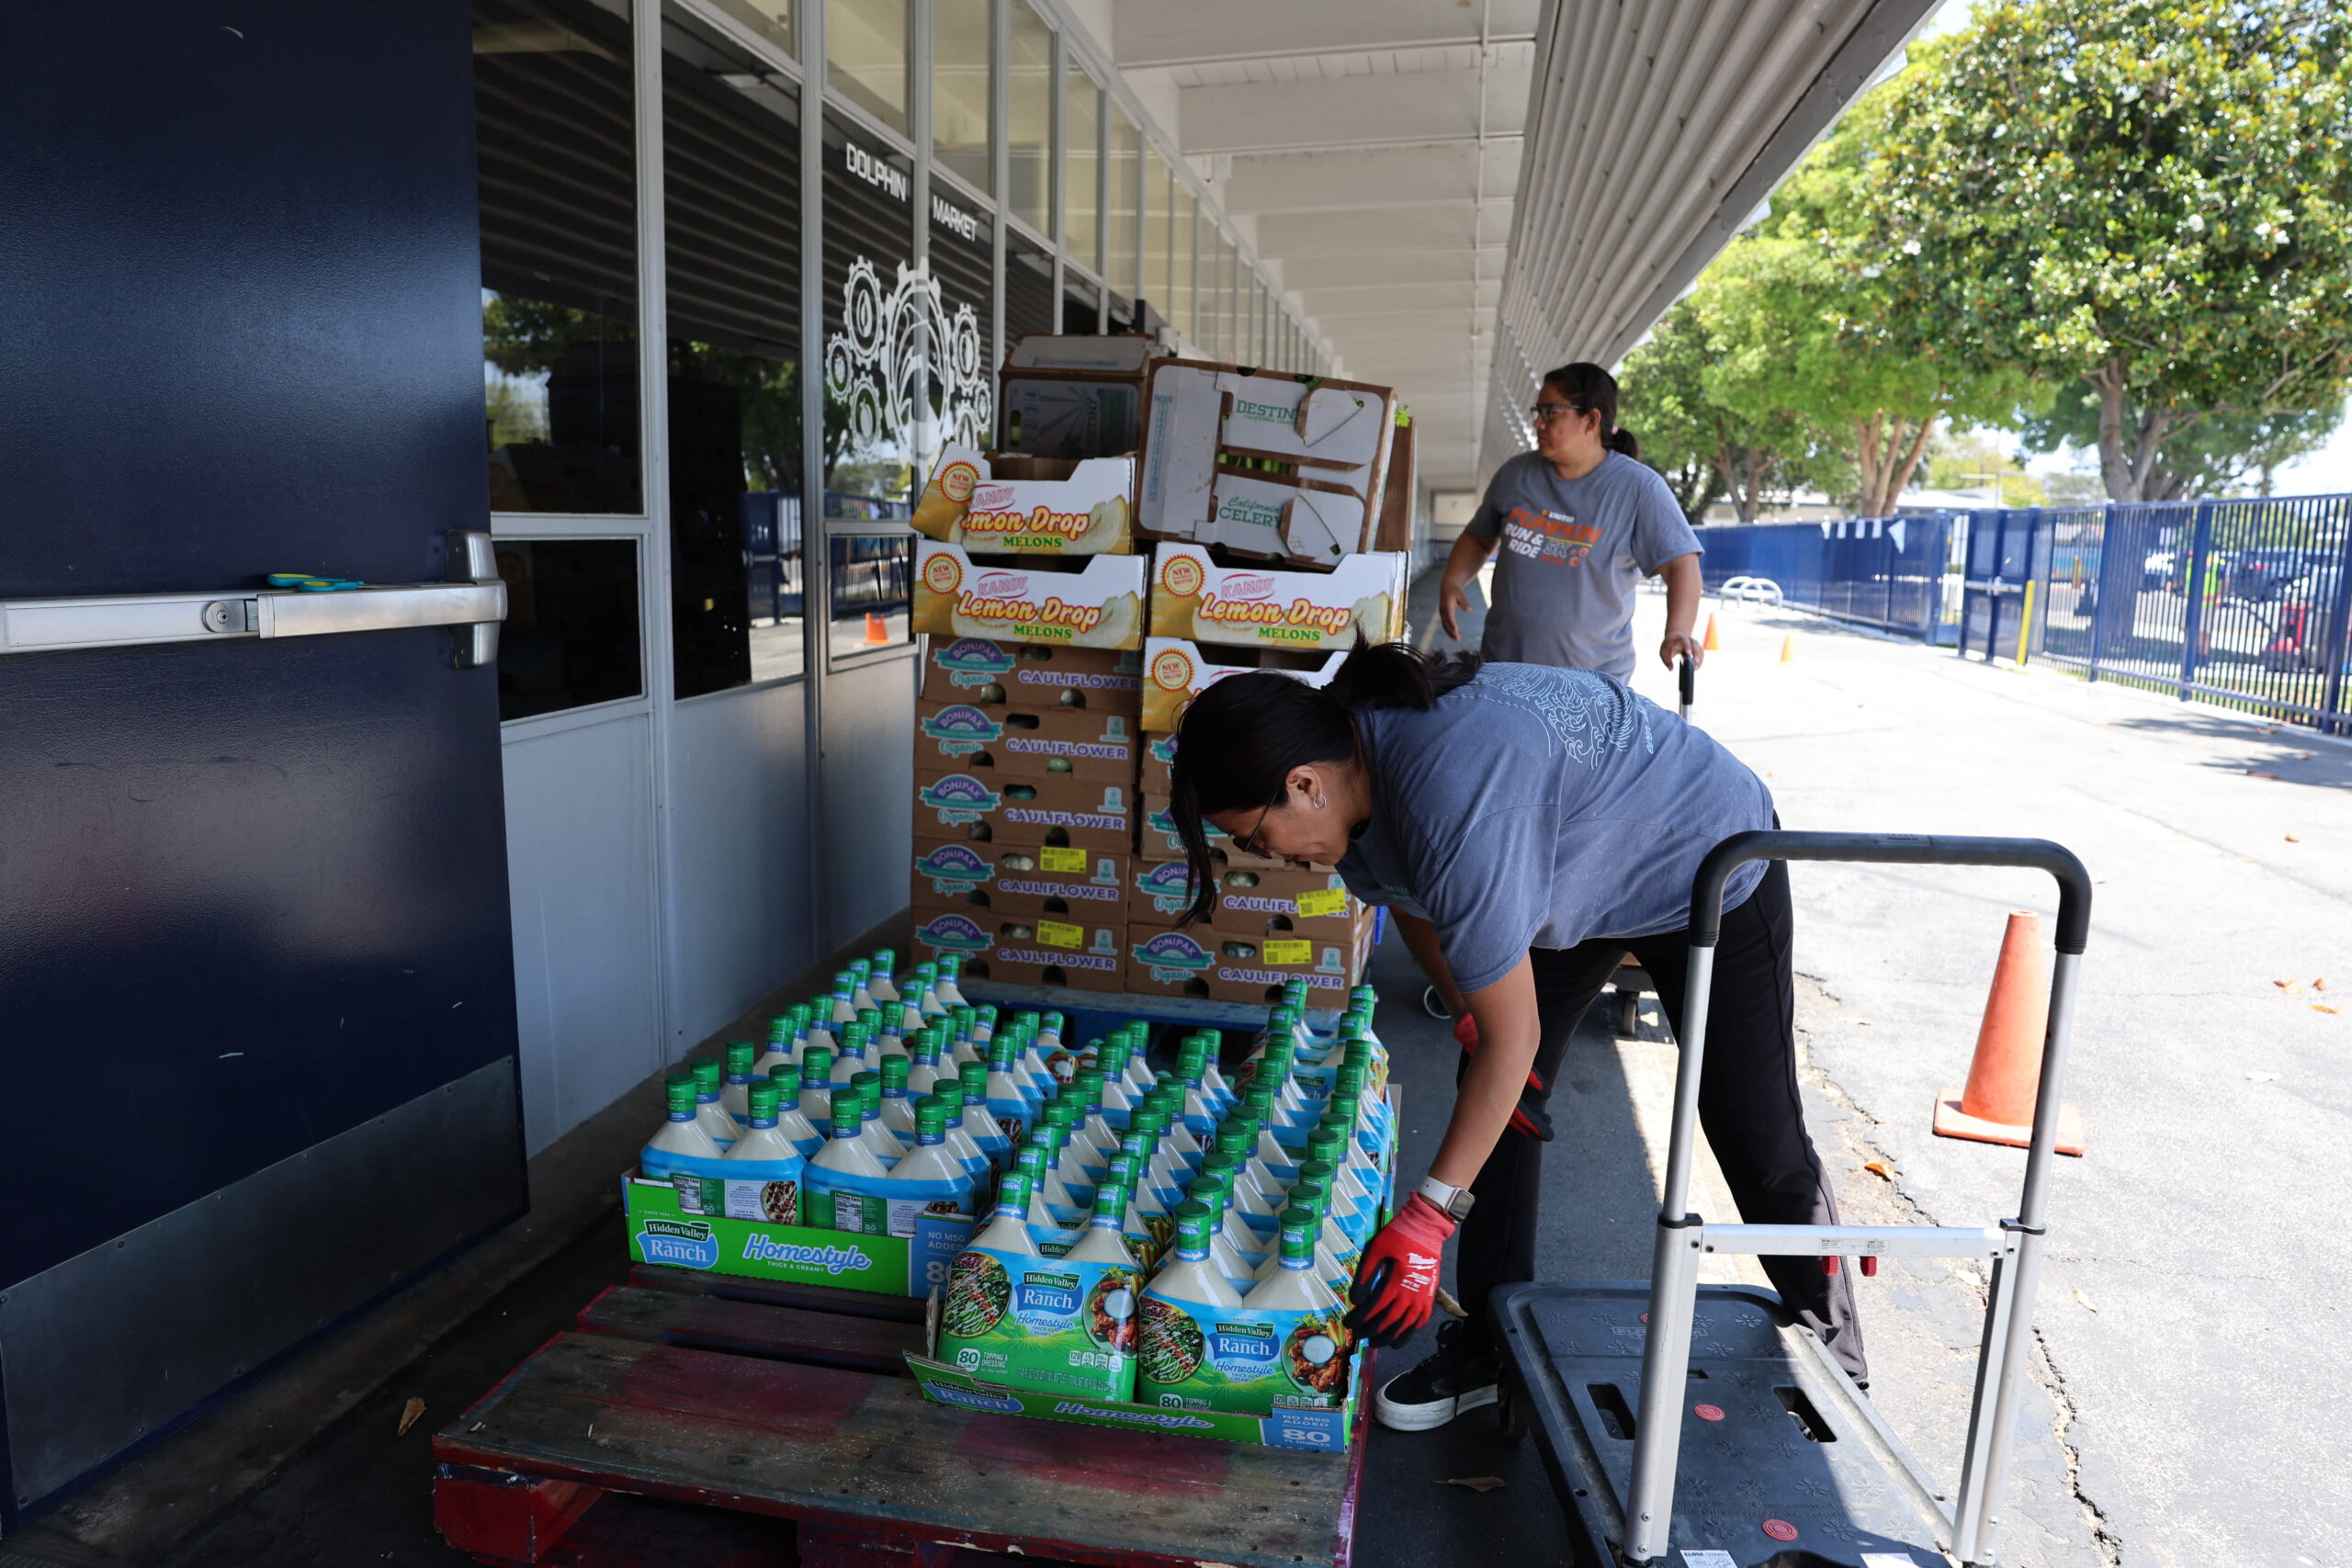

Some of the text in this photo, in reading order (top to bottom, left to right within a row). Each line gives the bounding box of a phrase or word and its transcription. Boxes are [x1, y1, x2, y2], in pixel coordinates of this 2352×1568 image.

[846, 142, 978, 242] DOLPHIN MARKET
[1236, 400, 1297, 421] DESTIN
[1227, 495, 1280, 513] California
[1028, 506, 1090, 541] Drop
[1002, 536, 1063, 548] MELONS
[1505, 522, 1544, 547] RUN &
[1509, 538, 1542, 558] RIDE
[1544, 540, 1572, 558] 5K
[978, 576, 1029, 597] KANDY
[1221, 577, 1275, 599] KANDY
[957, 591, 1101, 634] Lemon Drop
[1198, 592, 1351, 637] Lemon Drop
[1013, 625, 1073, 639] MELONS
[1258, 626, 1321, 641] MELONS
[954, 640, 998, 660] BONIPAK
[952, 671, 994, 688] Organic
[1019, 670, 1141, 690] CAULIFLOWER
[940, 711, 984, 729] BONIPAK
[939, 741, 982, 757] Organic
[1006, 739, 1128, 760] CAULIFLOWER
[937, 780, 981, 799] BONIPAK
[938, 809, 980, 826] Organic
[1004, 808, 1125, 830] CAULIFLOWER
[933, 851, 977, 869] BONIPAK
[933, 881, 976, 897] Organic
[999, 879, 1119, 901] CAULIFLOWER
[933, 919, 976, 938] BONIPAK
[1150, 938, 1196, 955] BONIPAK
[998, 948, 1117, 971] CAULIFLOWER
[1150, 966, 1193, 985] Organic
[649, 1224, 707, 1240] Hidden Valley
[928, 1232, 965, 1242] NO MSG
[650, 1239, 707, 1262] Ranch
[742, 1233, 872, 1275] Homestyle
[928, 1241, 964, 1251] ADDED
[1041, 1245, 1066, 1254] Hidden
[926, 1260, 951, 1283] 8
[1026, 1274, 1076, 1289] Hidden Valley
[1024, 1289, 1073, 1309] Ranch
[1015, 1312, 1074, 1332] Homestyle
[1218, 1325, 1271, 1338] Hidden Valley
[1219, 1337, 1270, 1356] Ranch
[959, 1351, 978, 1364] 80
[981, 1359, 1006, 1368] DRESSING
[983, 1352, 1002, 1360] TOPPING
[1069, 1352, 1081, 1360] 120
[1214, 1360, 1274, 1378] Homestyle
[933, 1380, 1008, 1400] Hidden Valley
[1274, 1394, 1285, 1404] 120
[939, 1388, 1011, 1411] Ranch
[1161, 1396, 1181, 1408] 80
[1186, 1397, 1206, 1405] TOPPING
[1054, 1401, 1215, 1429] Homestyle
[1283, 1419, 1329, 1427] ADDED
[1283, 1428, 1331, 1443] 80
